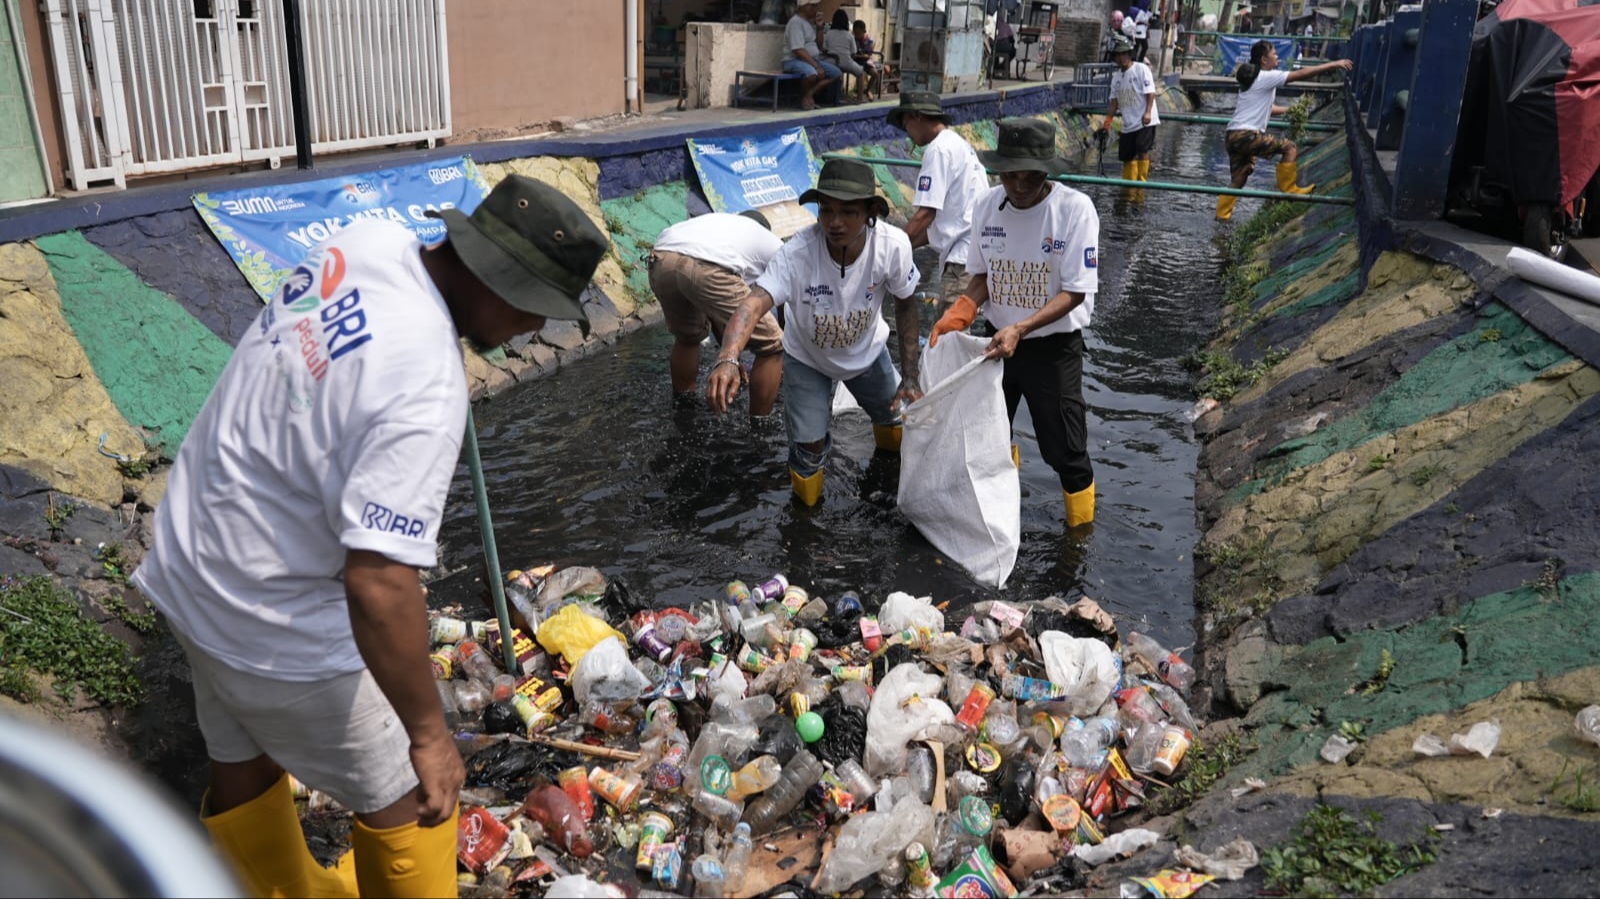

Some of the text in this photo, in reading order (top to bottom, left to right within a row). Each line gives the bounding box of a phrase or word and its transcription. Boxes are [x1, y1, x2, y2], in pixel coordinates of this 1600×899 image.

[761, 156, 778, 169] GAS
[440, 166, 463, 181] BRI
[356, 182, 376, 193] BRI
[222, 196, 277, 216] BUMN
[287, 216, 345, 249] YOK
[320, 287, 373, 361] BRI
[292, 316, 329, 381] peduli
